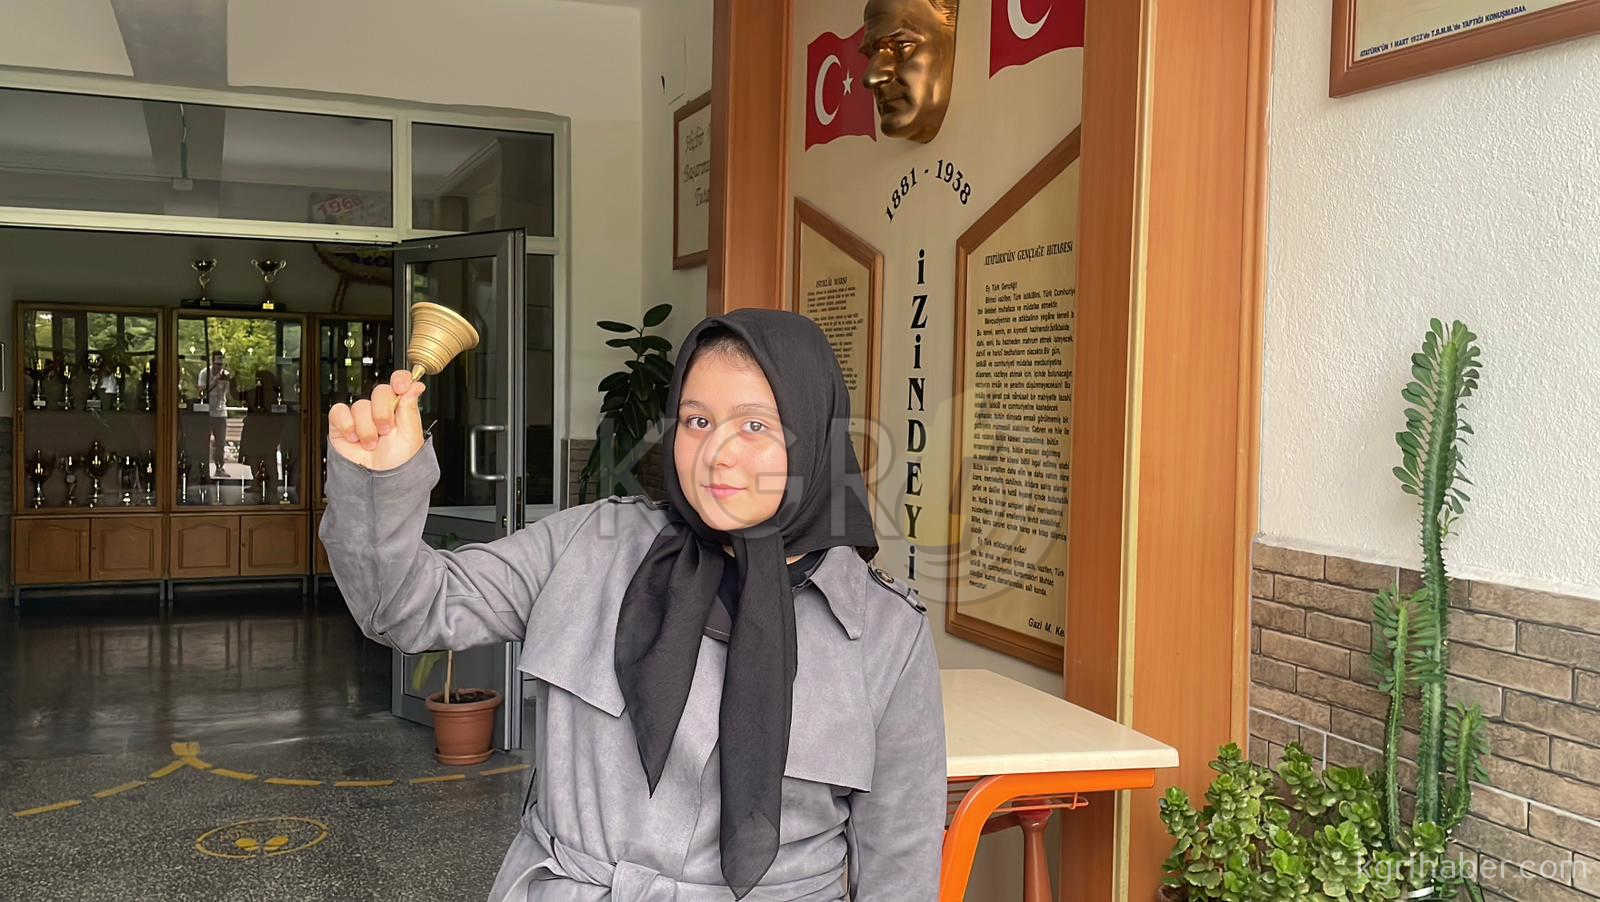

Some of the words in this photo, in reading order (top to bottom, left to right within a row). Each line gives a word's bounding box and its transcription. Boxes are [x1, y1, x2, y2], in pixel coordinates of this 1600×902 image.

[1360, 44, 1388, 57] ATATÜRK'ÜN
[1394, 38, 1409, 47] MART
[1462, 16, 1484, 28] YAPTIĞI
[885, 168, 918, 221] 1881
[936, 159, 971, 205] 1938
[904, 248, 928, 600] İZİNDEYİ
[1028, 618, 1042, 630] Gazi
